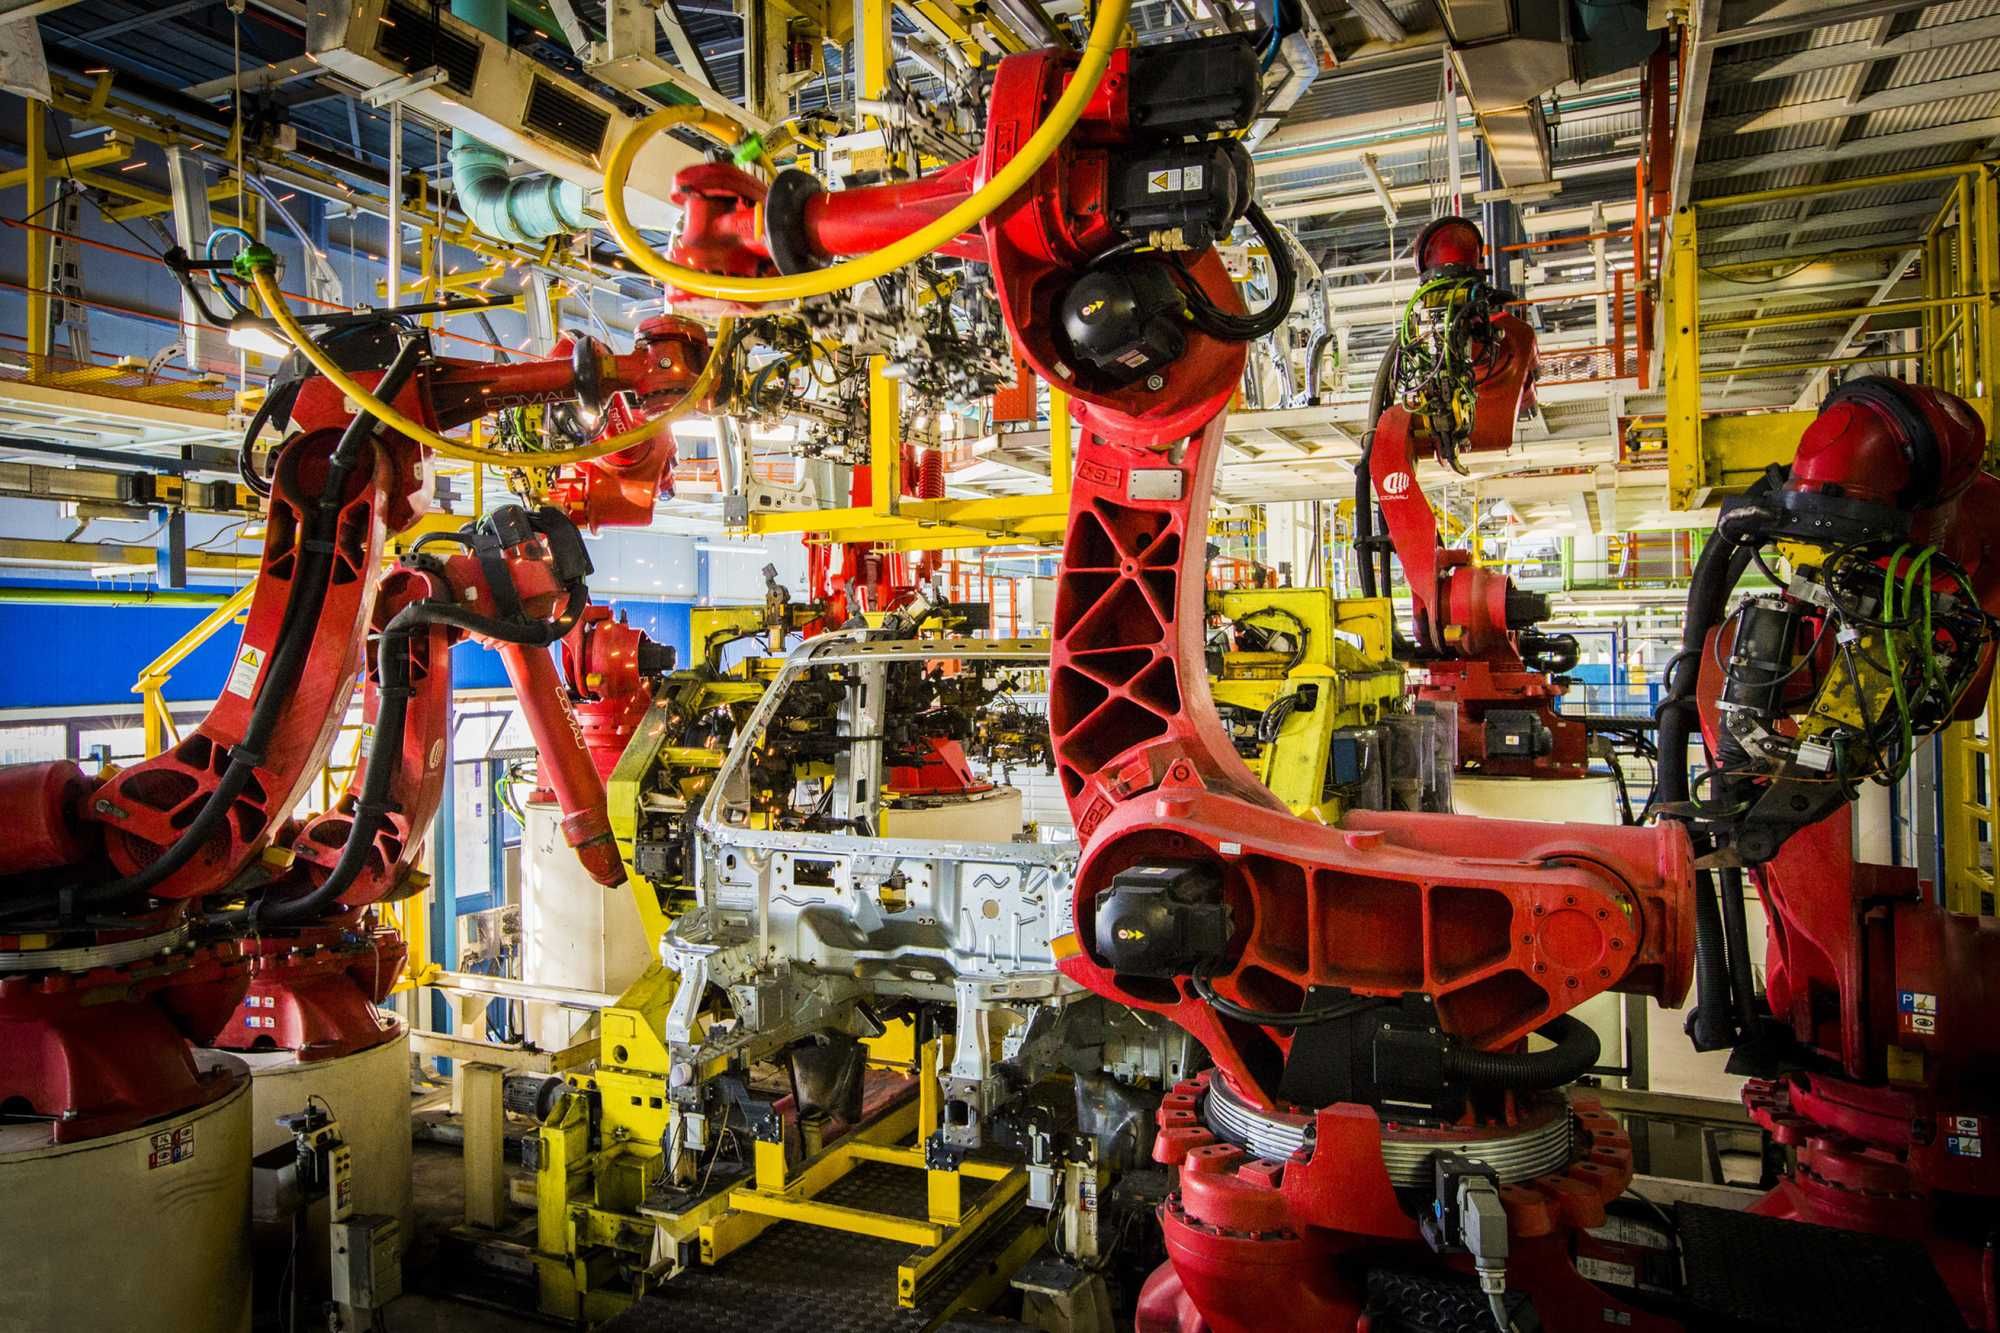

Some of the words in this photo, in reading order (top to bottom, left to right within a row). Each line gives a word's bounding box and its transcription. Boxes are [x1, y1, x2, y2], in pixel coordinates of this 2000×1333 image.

[555, 686, 586, 750] COMAU
[1902, 993, 1913, 1005] P
[1948, 1137, 1958, 1148] P
